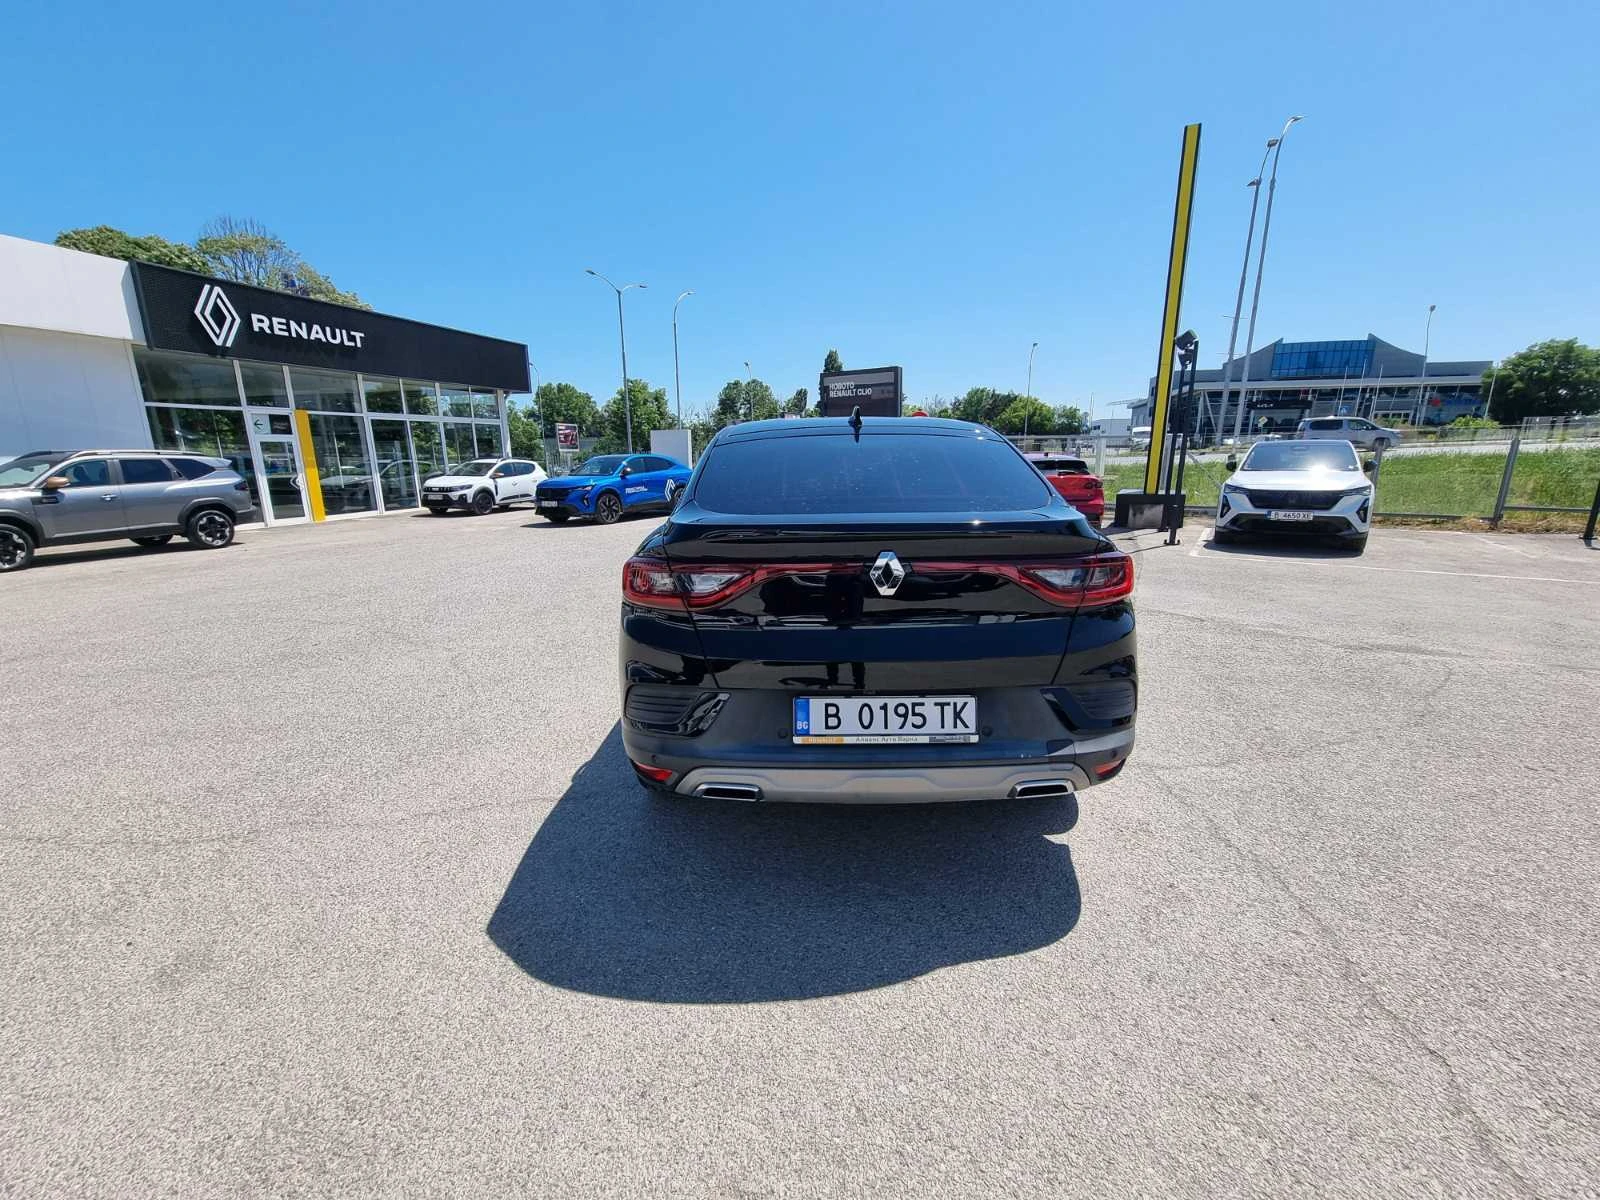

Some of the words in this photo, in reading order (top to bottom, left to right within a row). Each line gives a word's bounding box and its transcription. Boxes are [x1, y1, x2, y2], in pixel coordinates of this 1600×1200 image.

[251, 313, 365, 348] RENAULT
[829, 389, 856, 397] RENAULT
[796, 720, 809, 730] BG
[824, 702, 842, 731] B
[858, 702, 927, 730] 0195
